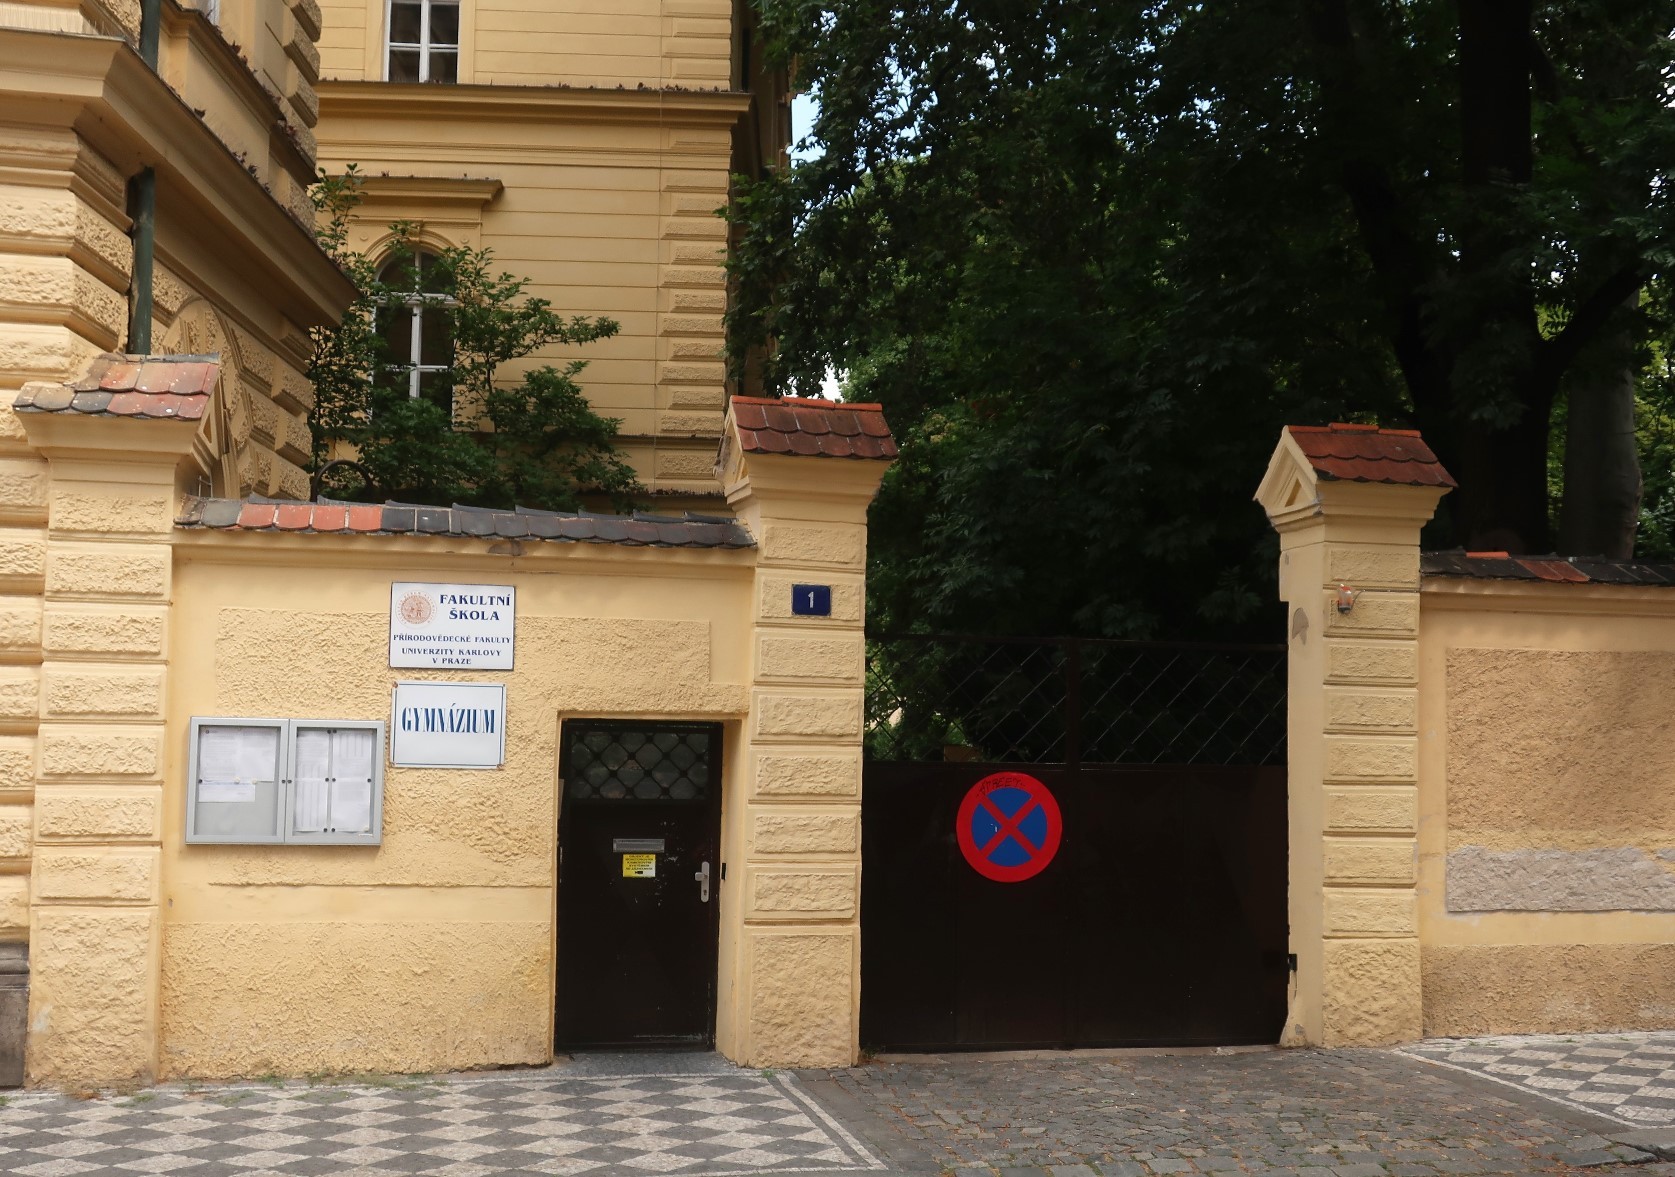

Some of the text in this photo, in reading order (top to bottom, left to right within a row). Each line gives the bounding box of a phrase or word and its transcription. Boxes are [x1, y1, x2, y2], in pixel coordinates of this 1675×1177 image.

[440, 593, 511, 606] FAKULTNÍ
[808, 591, 814, 608] 1
[449, 608, 500, 621] ŠKOLA
[393, 632, 511, 644] PŘÍRODOVĚDECKÉ FAKULTY
[401, 647, 502, 657] UNIVERZITY KARLOVY
[442, 657, 472, 665] PRAZE
[401, 702, 495, 734] GYMNÁZIUM
